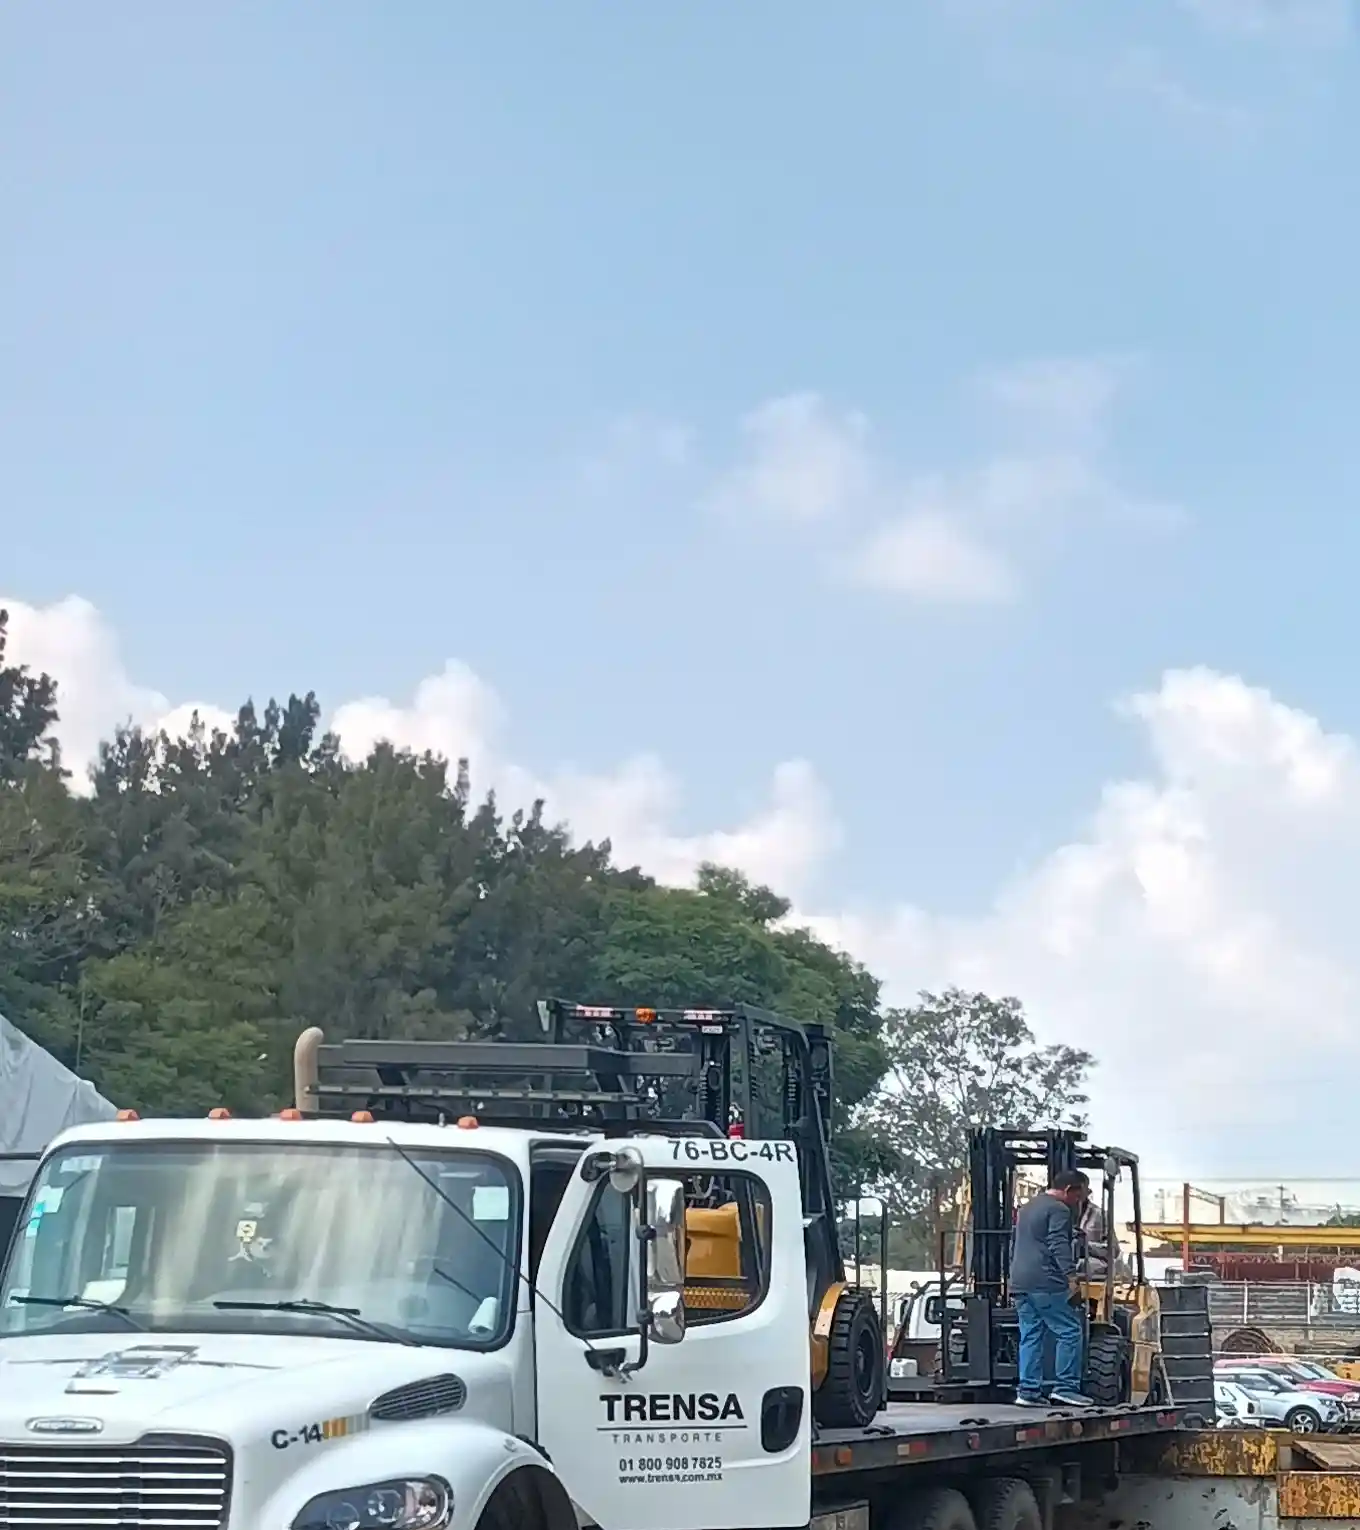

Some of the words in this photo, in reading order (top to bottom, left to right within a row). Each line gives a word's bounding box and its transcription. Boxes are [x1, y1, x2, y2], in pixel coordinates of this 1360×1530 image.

[668, 1140, 794, 1162] 76-BC-4R
[600, 1393, 744, 1421] TRENSA
[613, 1432, 722, 1443] TRANSPORTE
[619, 1459, 634, 1471] 01
[638, 1457, 662, 1470] 800
[666, 1457, 689, 1469] 908
[692, 1456, 722, 1469] 7825
[619, 1473, 722, 1483] www.trensa.com.mx
